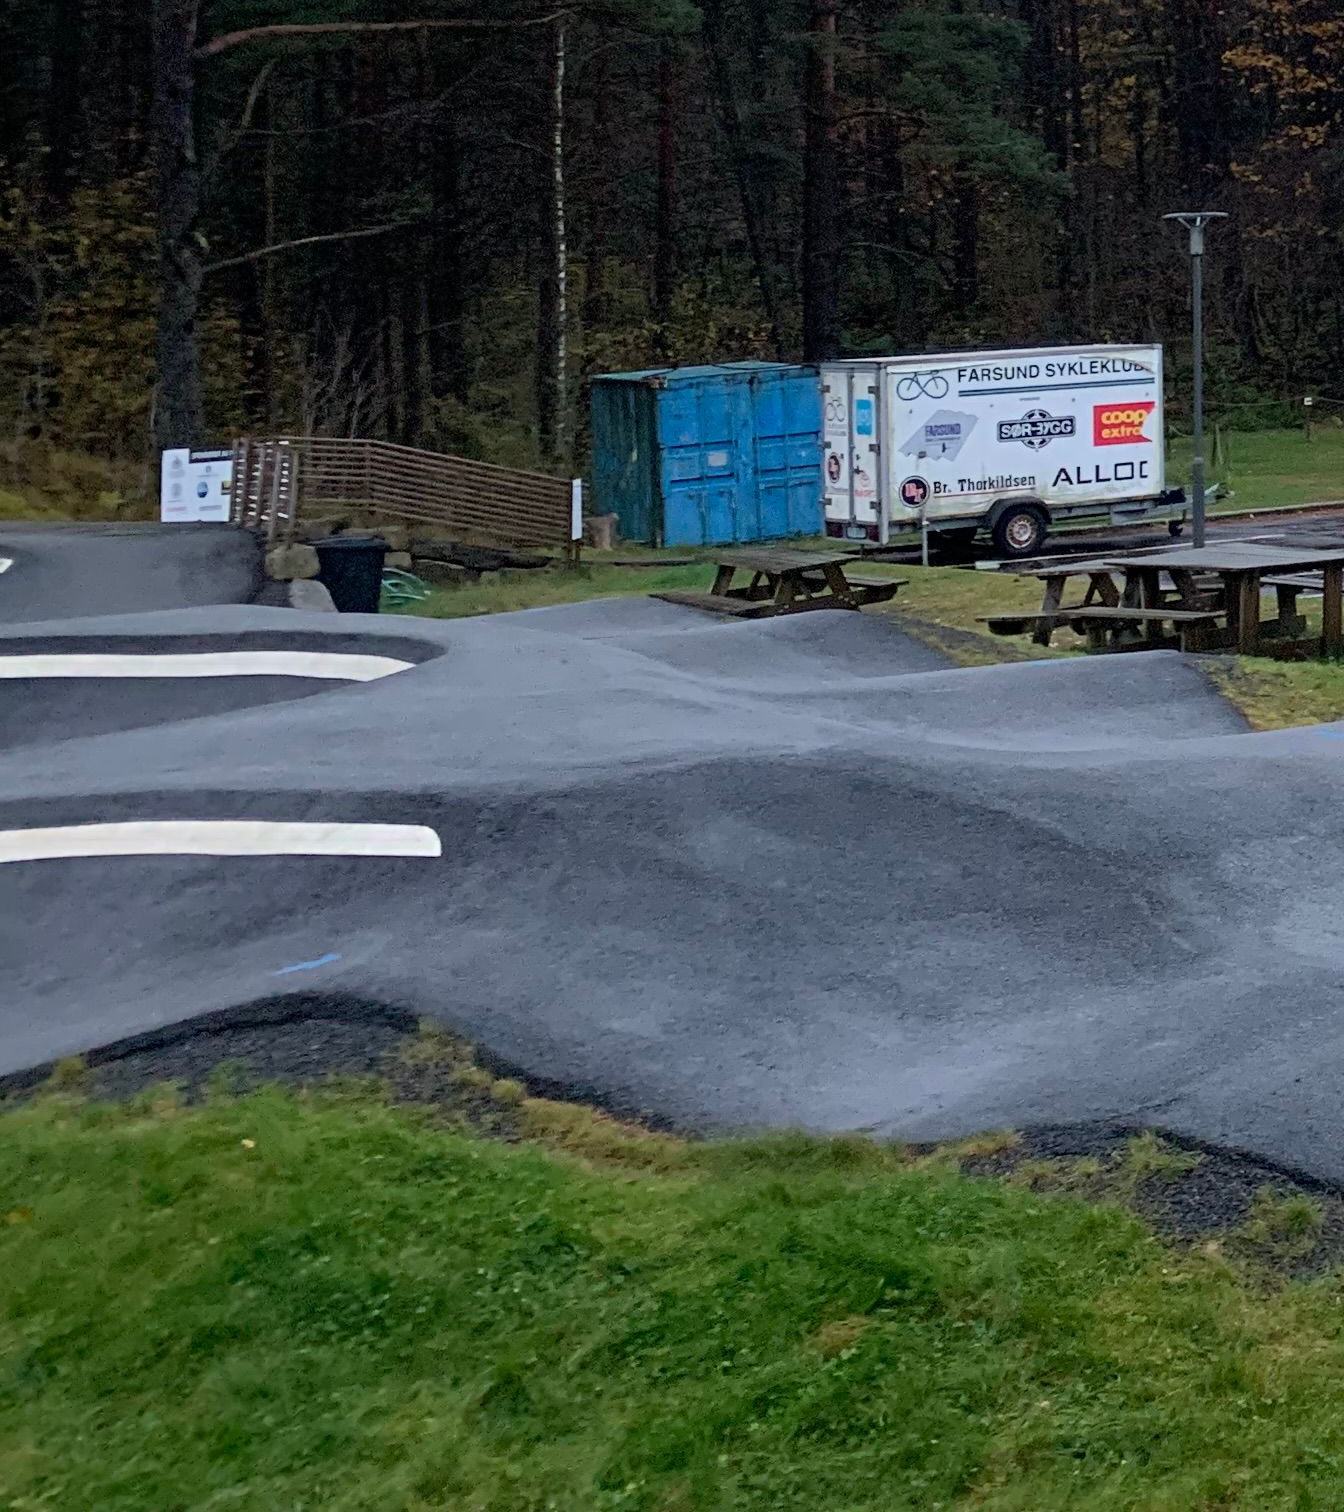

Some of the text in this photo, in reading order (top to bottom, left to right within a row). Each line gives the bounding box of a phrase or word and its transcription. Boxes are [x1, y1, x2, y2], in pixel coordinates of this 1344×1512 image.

[958, 364, 1040, 383] FARSUND
[1101, 409, 1148, 425] coop
[1101, 425, 1142, 439] extra
[933, 474, 1036, 494] Br. Thorkildsen
